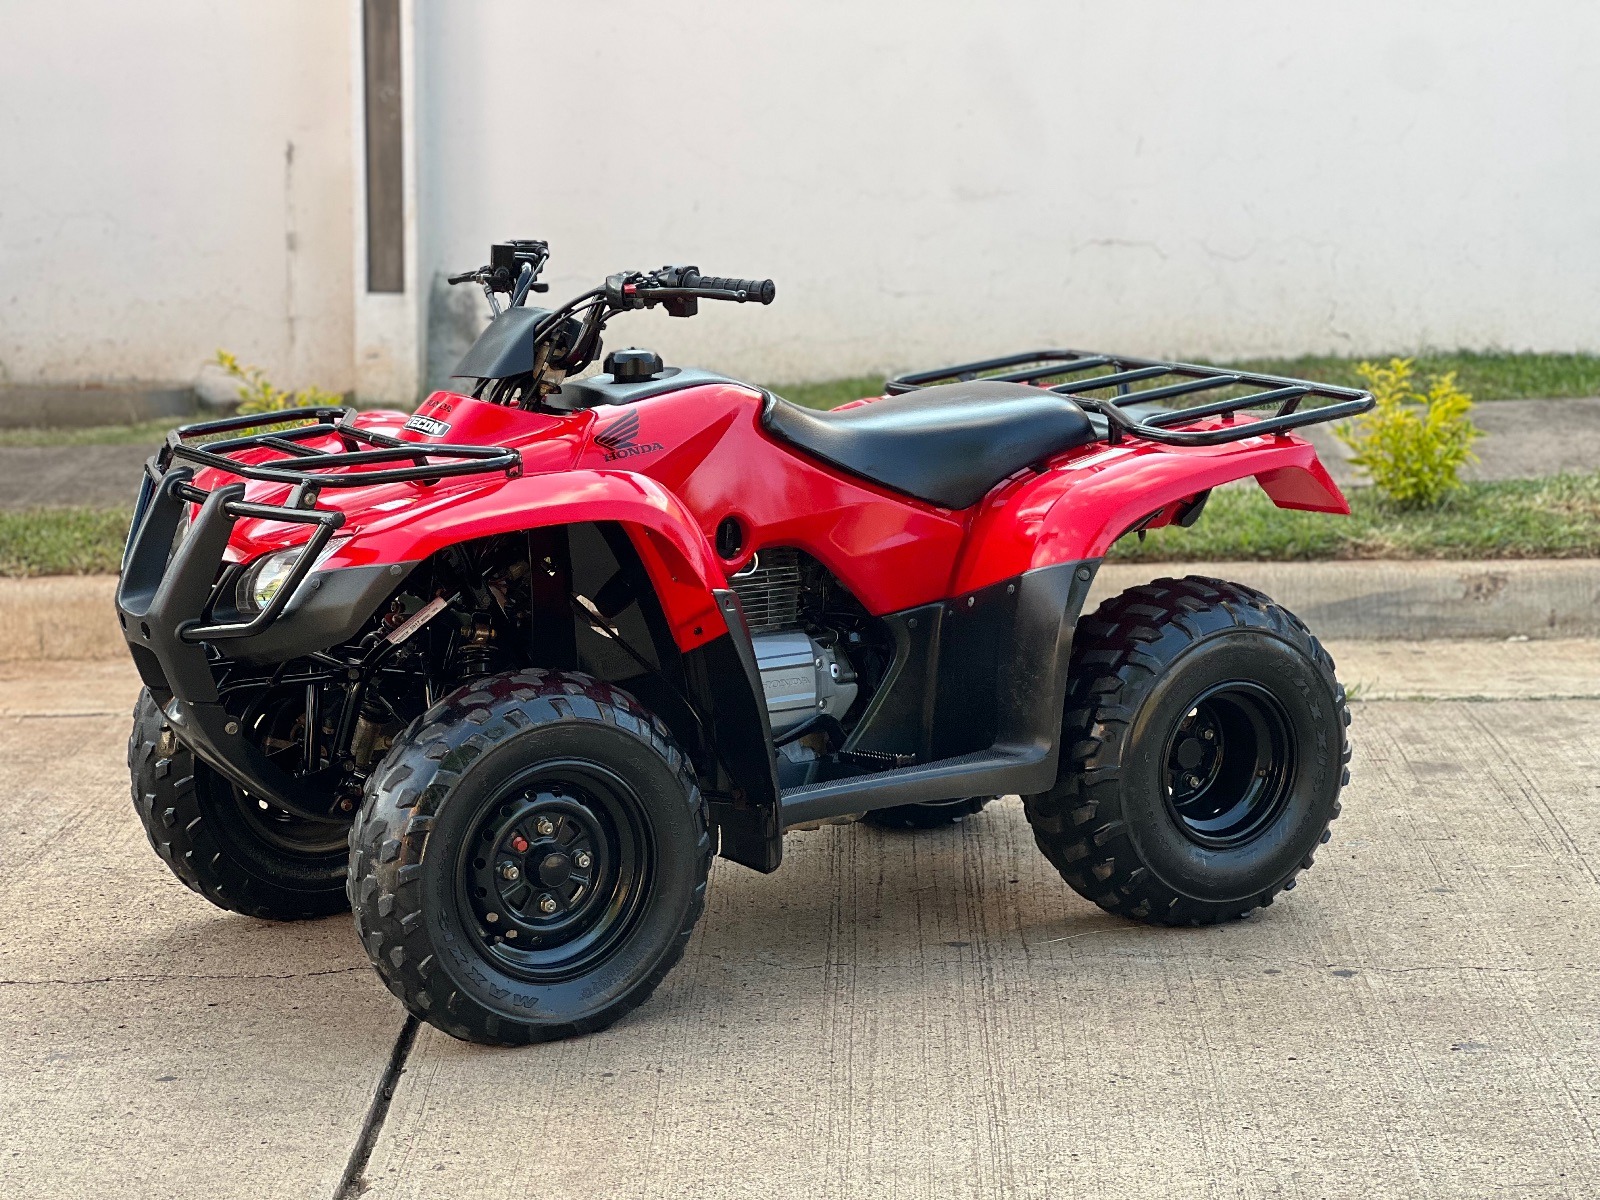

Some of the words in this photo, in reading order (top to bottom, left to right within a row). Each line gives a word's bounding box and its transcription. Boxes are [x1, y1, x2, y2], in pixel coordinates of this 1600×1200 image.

[404, 416, 445, 435] RECON
[603, 442, 664, 462] HONDA
[437, 907, 540, 1009] MAXXIS
